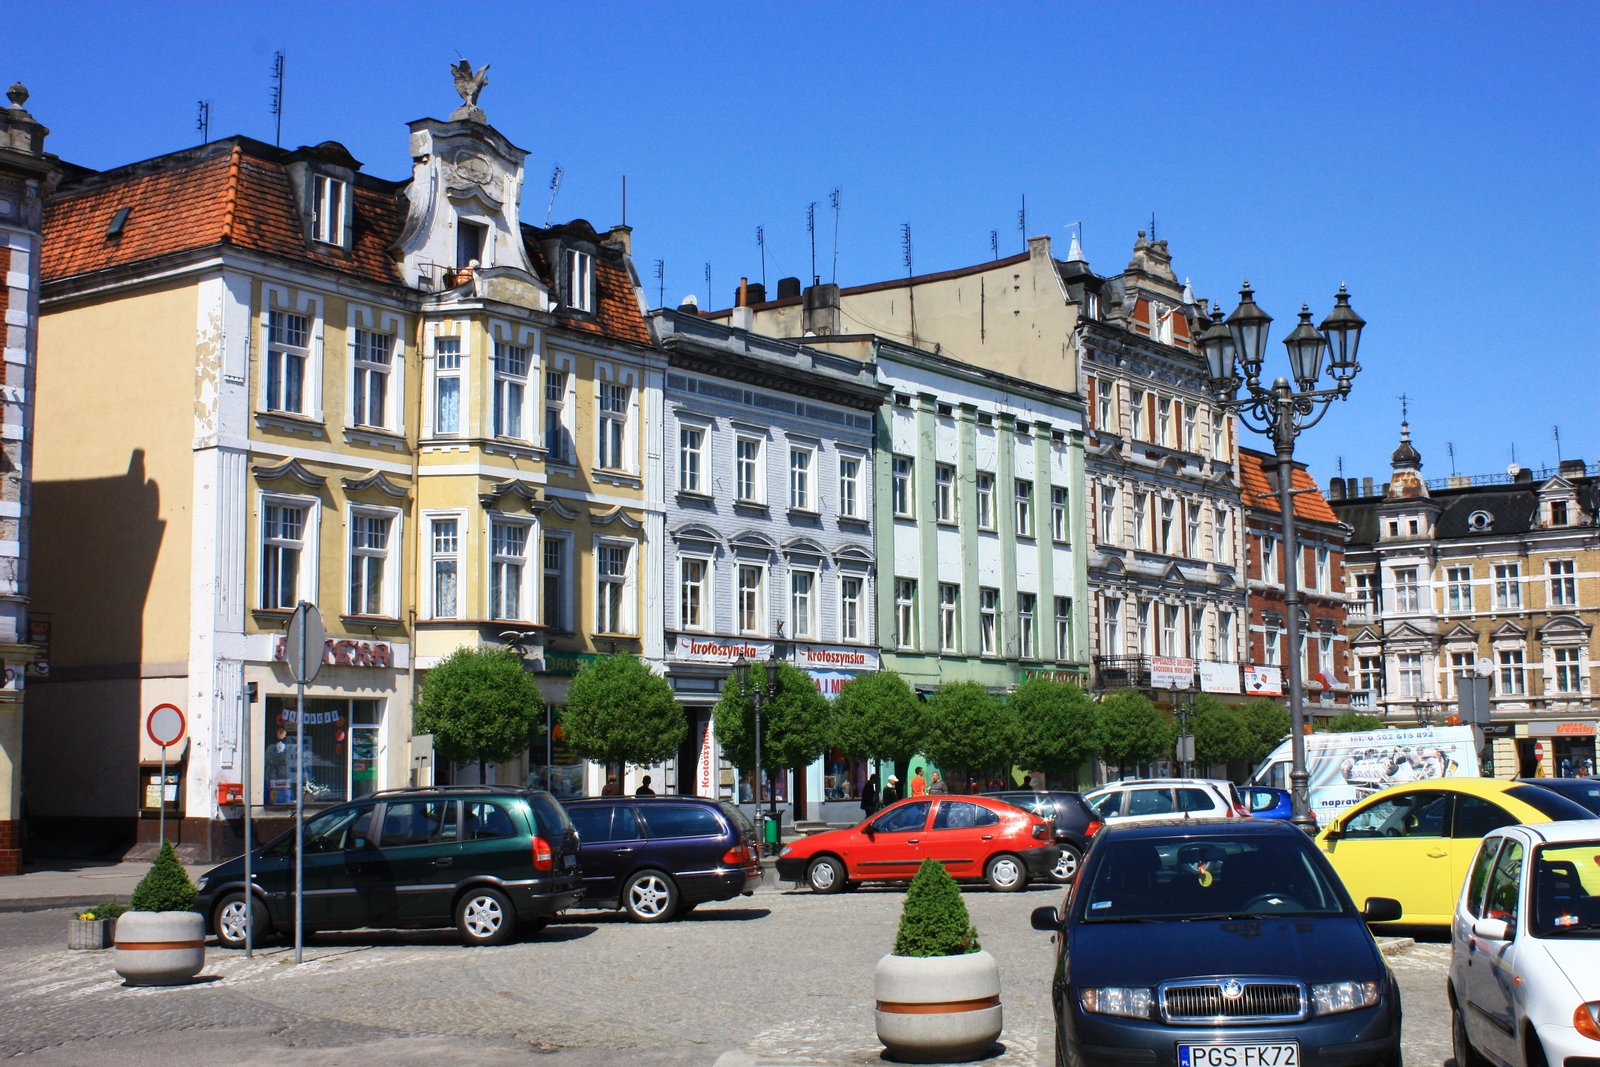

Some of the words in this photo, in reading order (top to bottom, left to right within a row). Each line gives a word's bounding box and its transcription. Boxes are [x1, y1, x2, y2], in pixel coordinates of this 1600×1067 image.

[1416, 730, 1435, 739] 892
[1321, 798, 1363, 808] napraw
[1192, 1047, 1238, 1067] PGS
[1244, 1046, 1296, 1067] FK72
